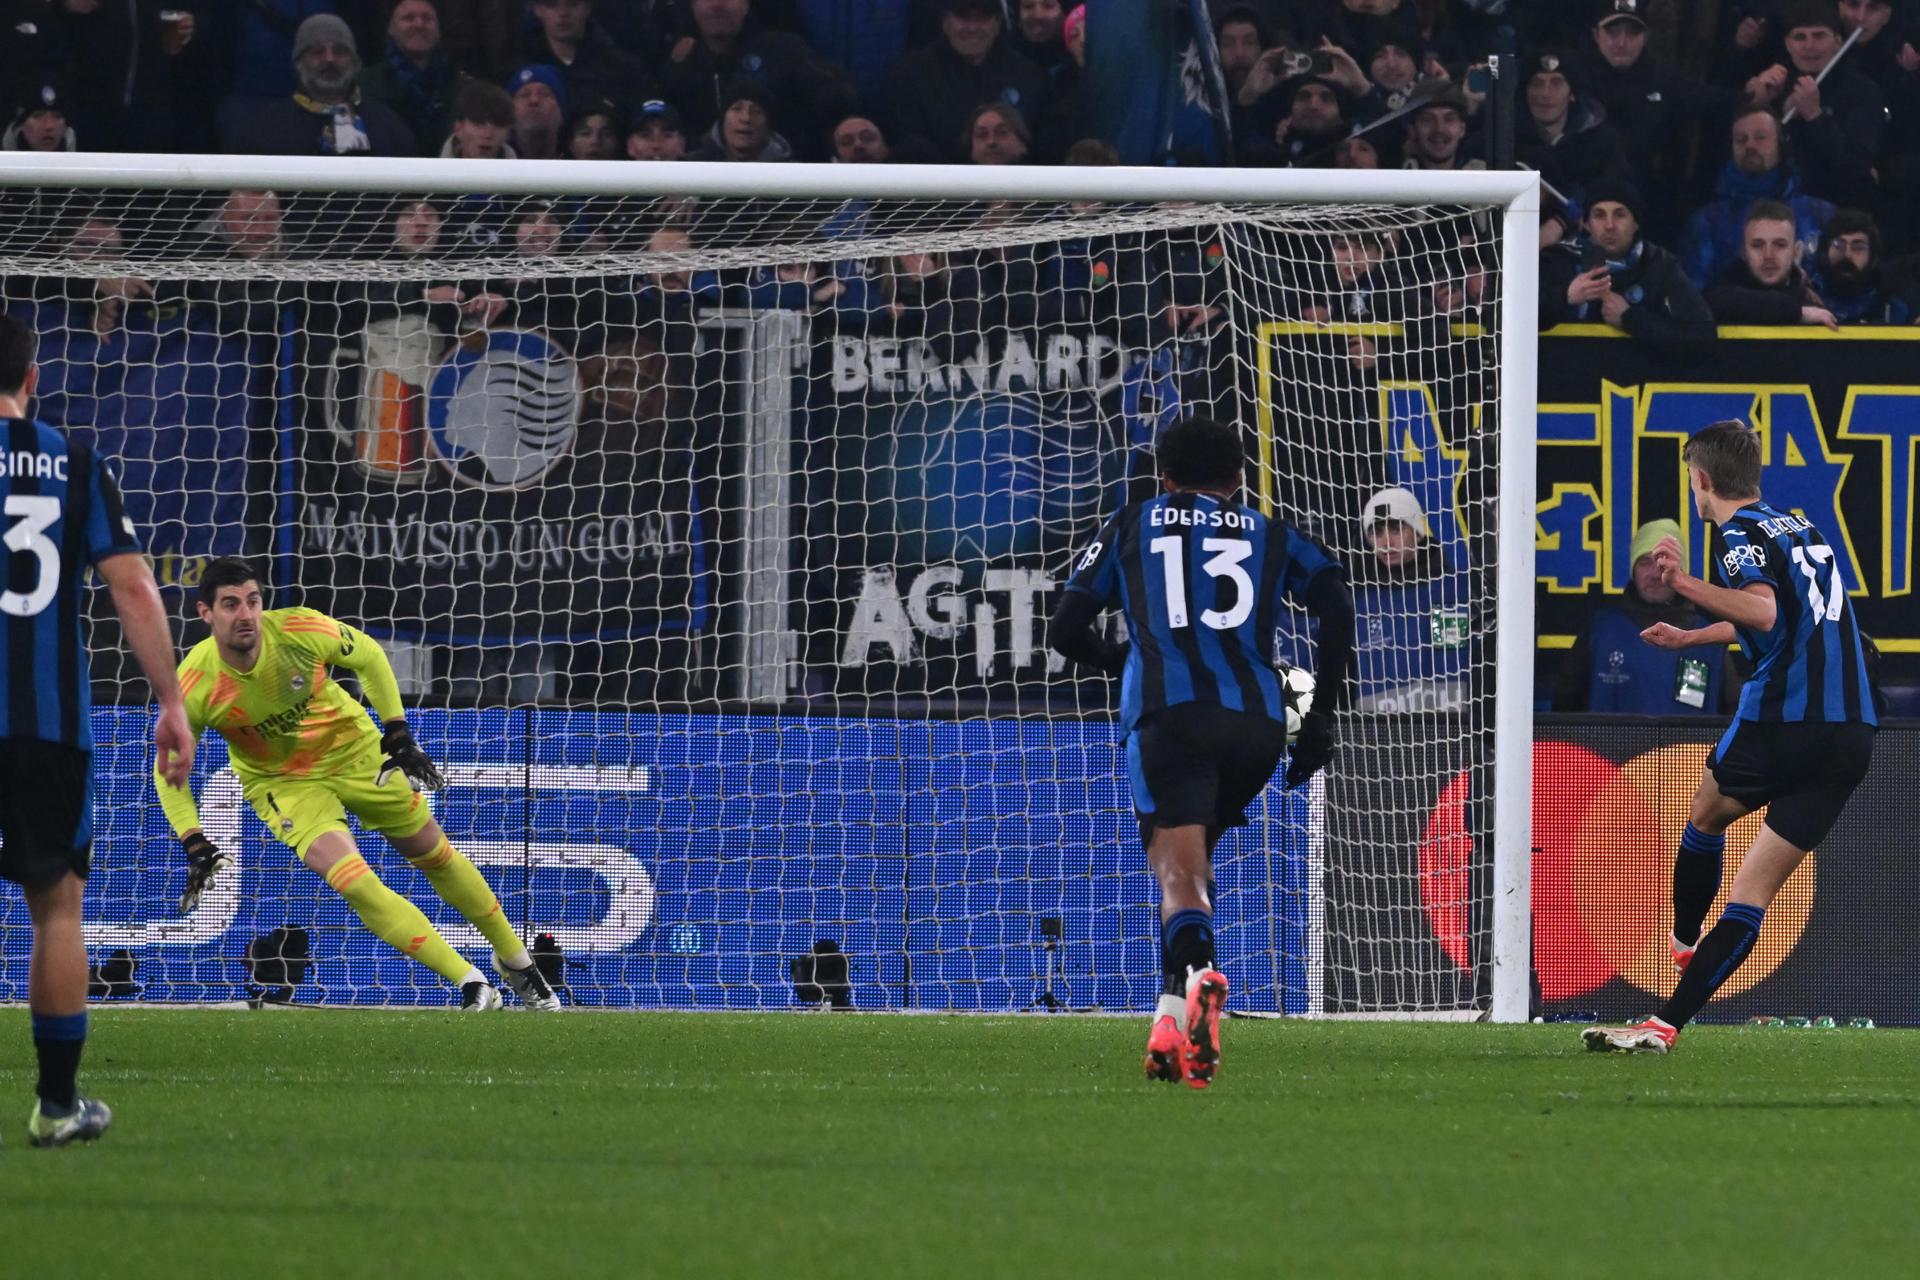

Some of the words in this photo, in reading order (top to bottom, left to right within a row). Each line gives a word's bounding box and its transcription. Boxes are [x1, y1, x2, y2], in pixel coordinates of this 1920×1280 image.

[514, 523, 564, 569] UN
[579, 514, 685, 564] GOAL
[1151, 504, 1255, 531] ÉDERSON
[1151, 535, 1254, 630] 13
[1791, 544, 1844, 626] 17
